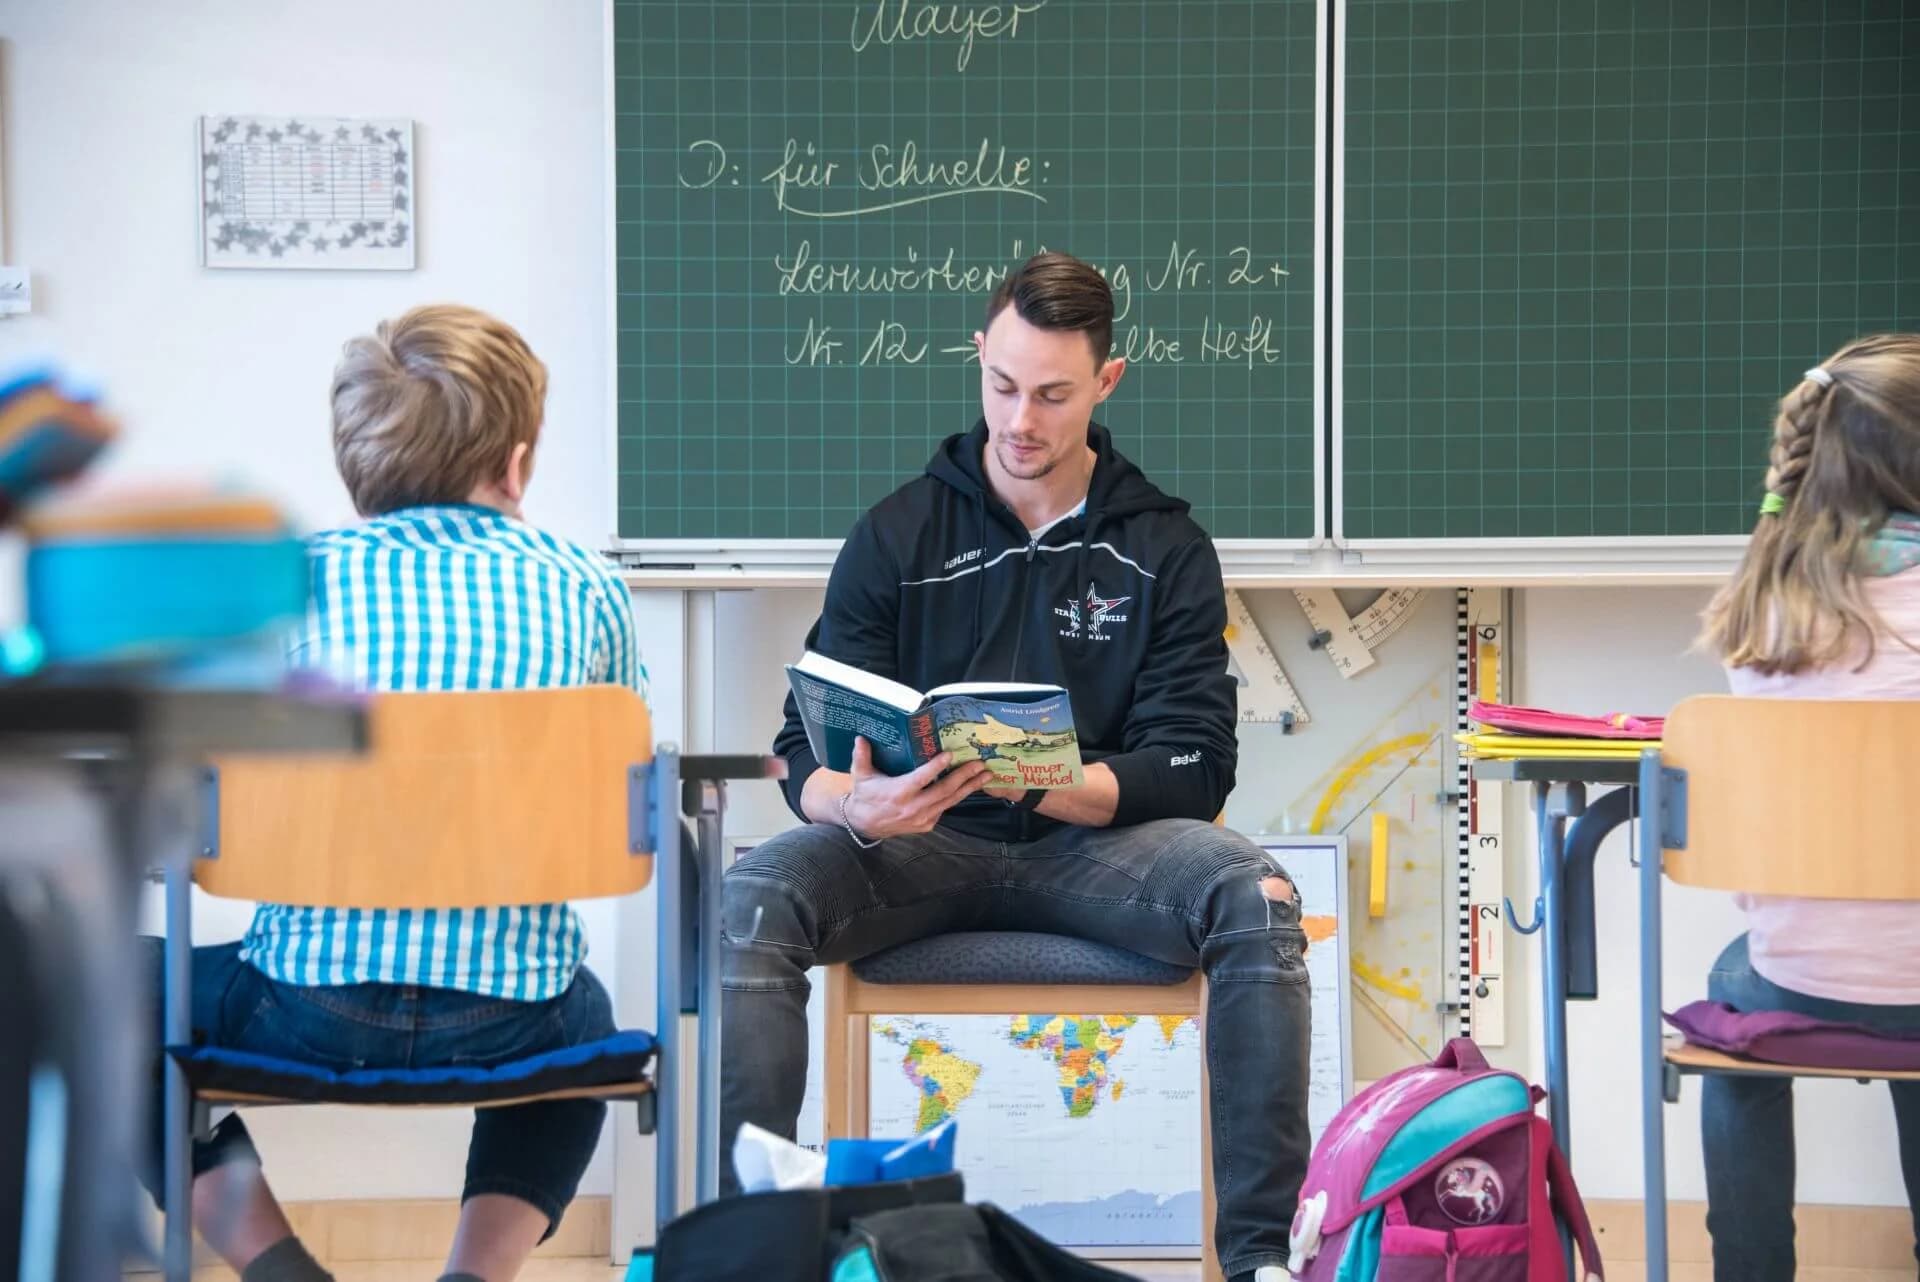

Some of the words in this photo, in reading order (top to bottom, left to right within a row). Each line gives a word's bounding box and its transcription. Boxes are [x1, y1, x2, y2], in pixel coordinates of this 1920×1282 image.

[851, 0, 1048, 72] Mayer
[761, 138, 839, 210] für
[858, 138, 1050, 191] Schnelle:
[1146, 241, 1211, 291] Nr.
[784, 318, 844, 366] Nr.
[860, 320, 928, 366] 12
[1201, 315, 1281, 370] Heft
[1017, 760, 1064, 773] Immer
[1023, 769, 1073, 787] Michel
[1479, 836, 1498, 848] 3
[1480, 906, 1499, 919] 2
